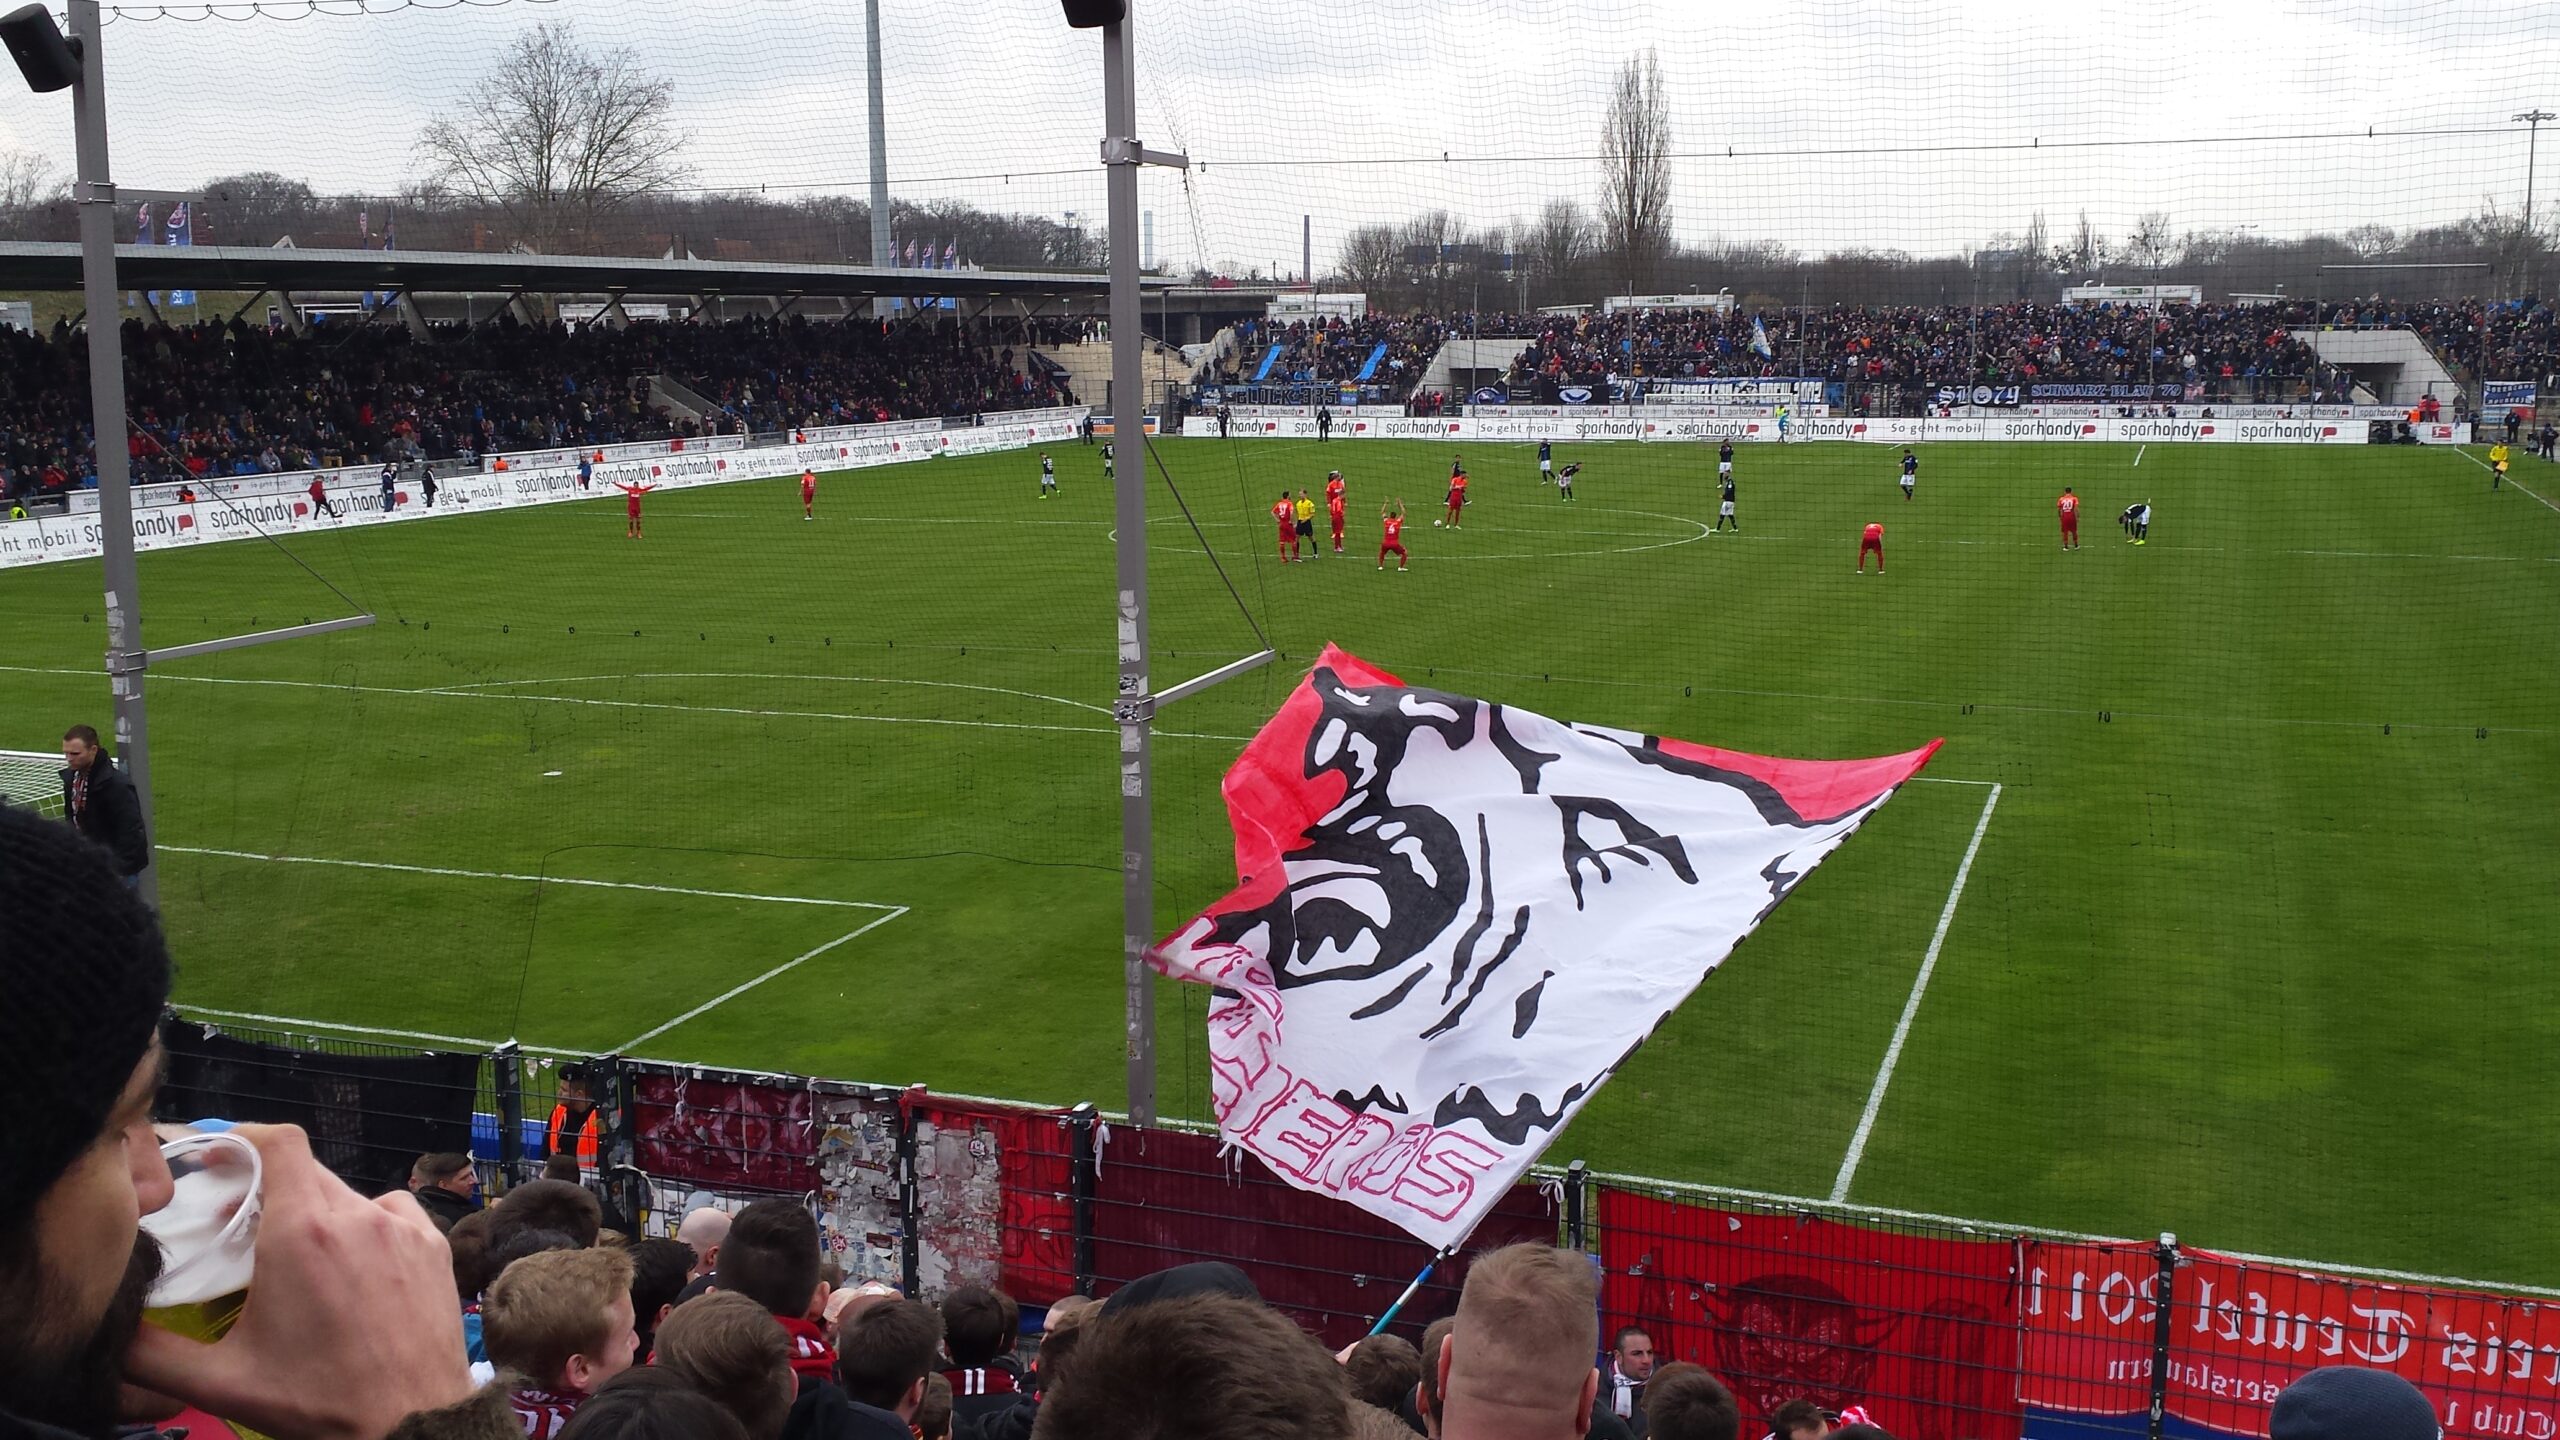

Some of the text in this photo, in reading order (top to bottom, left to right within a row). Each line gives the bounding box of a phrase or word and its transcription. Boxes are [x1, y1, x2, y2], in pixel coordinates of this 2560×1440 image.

[2052, 407, 2093, 418] sparhandy
[2359, 408, 2403, 419] sparhandy
[1386, 420, 1448, 439] sparhandy
[1480, 422, 1558, 436] So geht mobil
[1575, 420, 1643, 440] sparhandy
[1676, 420, 1745, 441] sparhandy
[1890, 422, 1982, 437] So geht mobil
[2005, 420, 2082, 439] sparhandy
[2120, 421, 2200, 440] sparhandy
[2241, 422, 2323, 442] sparhandy
[797, 443, 840, 464] sparhandy
[853, 441, 893, 458] sparhandy
[595, 462, 652, 488] sparhandy
[665, 452, 718, 479] sparhandy
[470, 484, 501, 499] mobil
[515, 471, 577, 499] sparhandy
[211, 498, 293, 530] sparhandy
[27, 528, 78, 552] mobil
